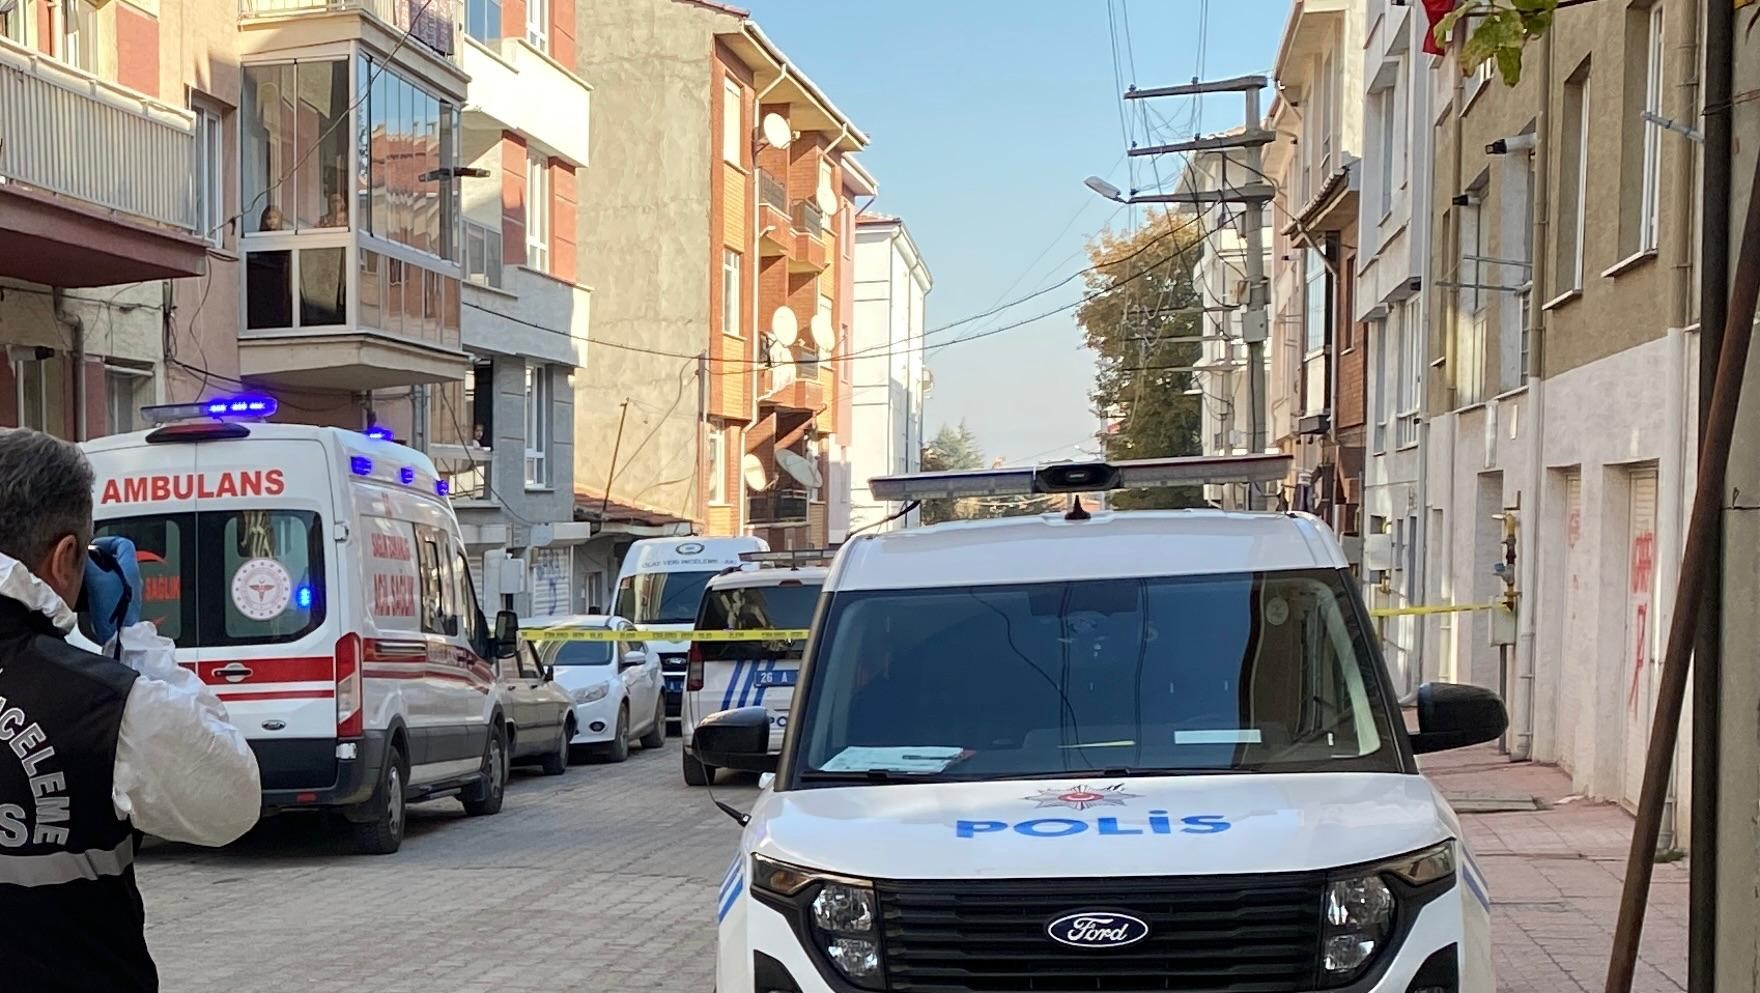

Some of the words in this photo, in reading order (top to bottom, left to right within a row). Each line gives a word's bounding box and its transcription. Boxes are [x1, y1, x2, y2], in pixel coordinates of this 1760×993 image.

[101, 469, 285, 504] AMBULANS
[760, 672, 773, 683] 26
[781, 672, 788, 682] A
[1067, 917, 1129, 942] Ford
